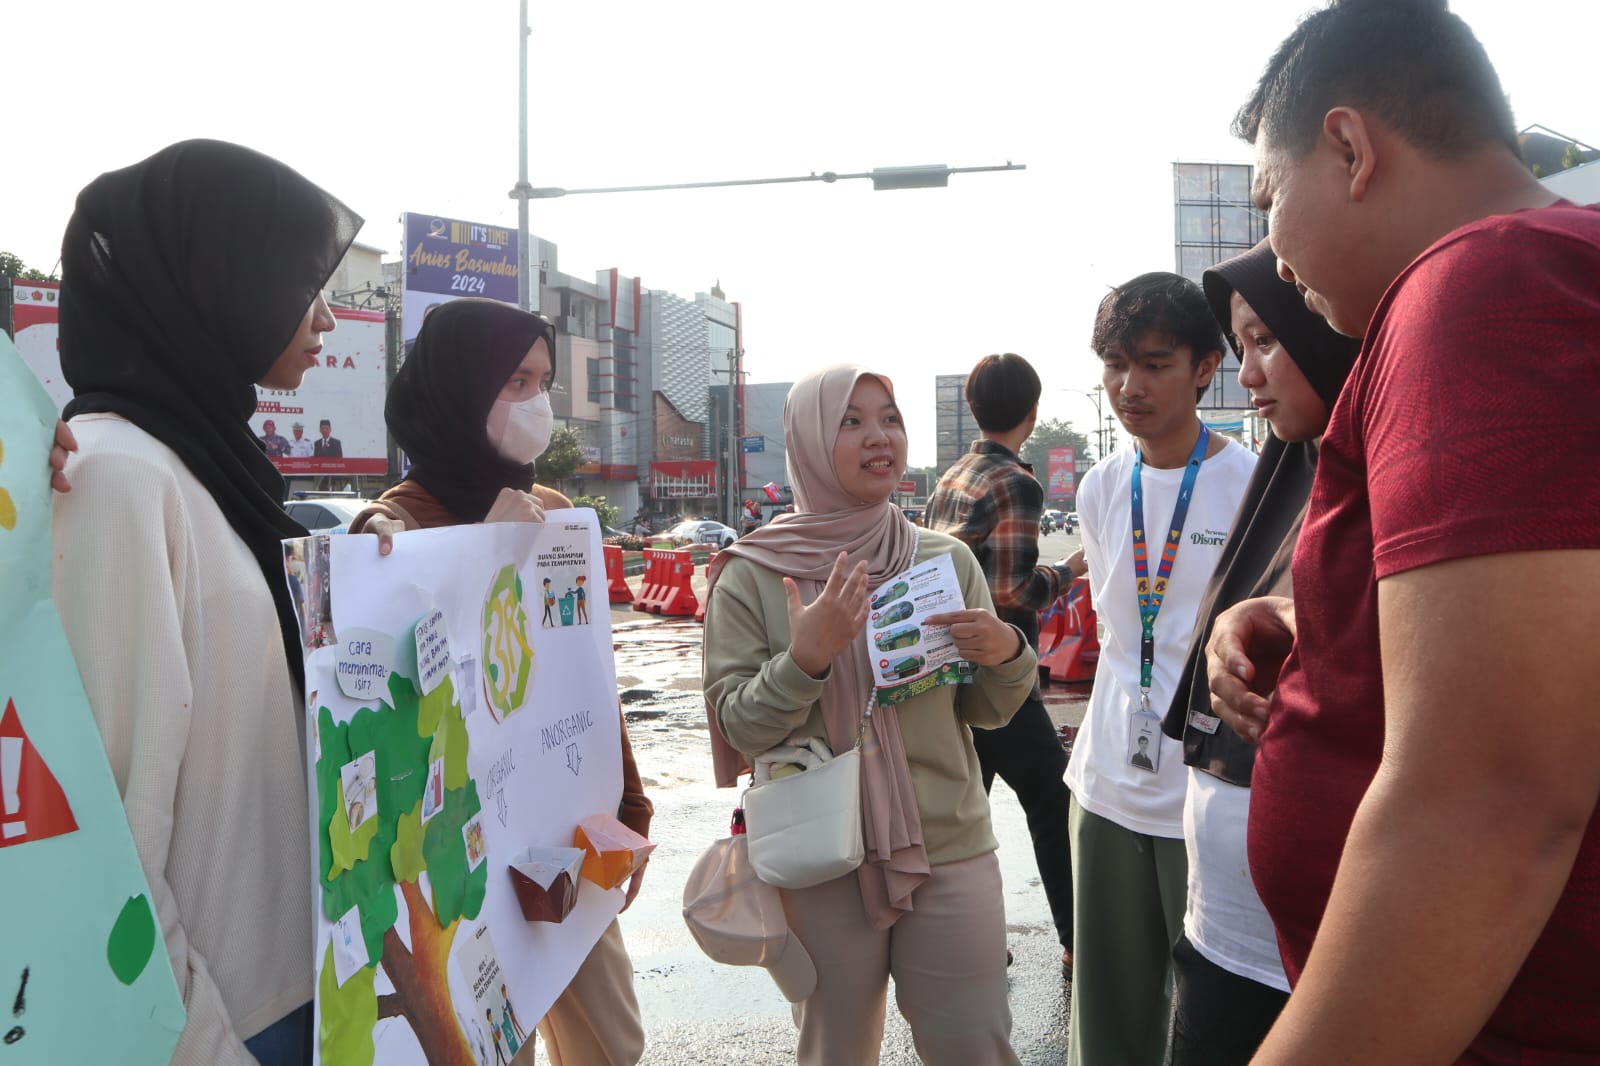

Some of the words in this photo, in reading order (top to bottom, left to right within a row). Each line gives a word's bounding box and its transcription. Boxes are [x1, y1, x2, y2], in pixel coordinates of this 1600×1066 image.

[471, 225, 487, 242] IT'S
[409, 242, 451, 268] Anies
[451, 274, 485, 293] 2024
[492, 591, 535, 704] 3R
[541, 710, 594, 754] ANORGANIC
[486, 747, 516, 800] ORGANIC
